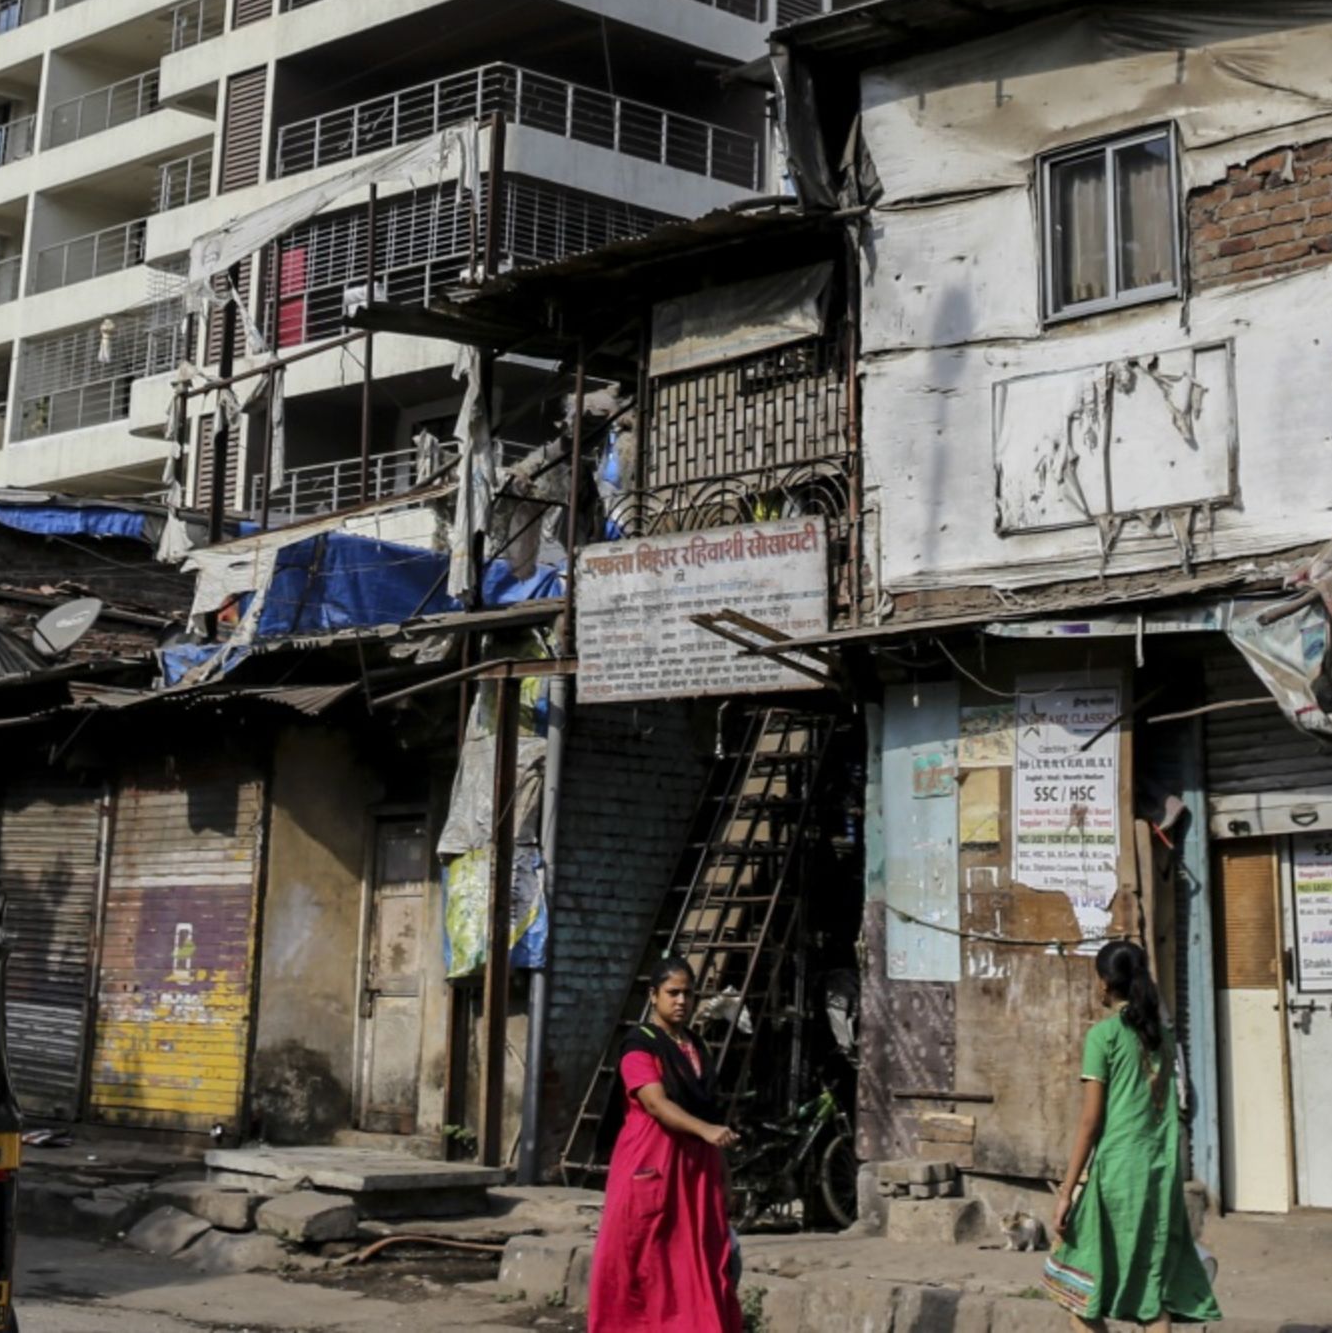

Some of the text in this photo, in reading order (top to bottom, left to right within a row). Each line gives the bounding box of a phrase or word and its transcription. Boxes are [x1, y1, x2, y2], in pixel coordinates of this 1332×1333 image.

[585, 552, 634, 579] एकता
[636, 542, 677, 574] विहार
[681, 530, 745, 567] रहिवाशी
[747, 522, 816, 558] सोसायटी
[1034, 786, 1058, 802] SSC
[1069, 786, 1096, 801] HSC
